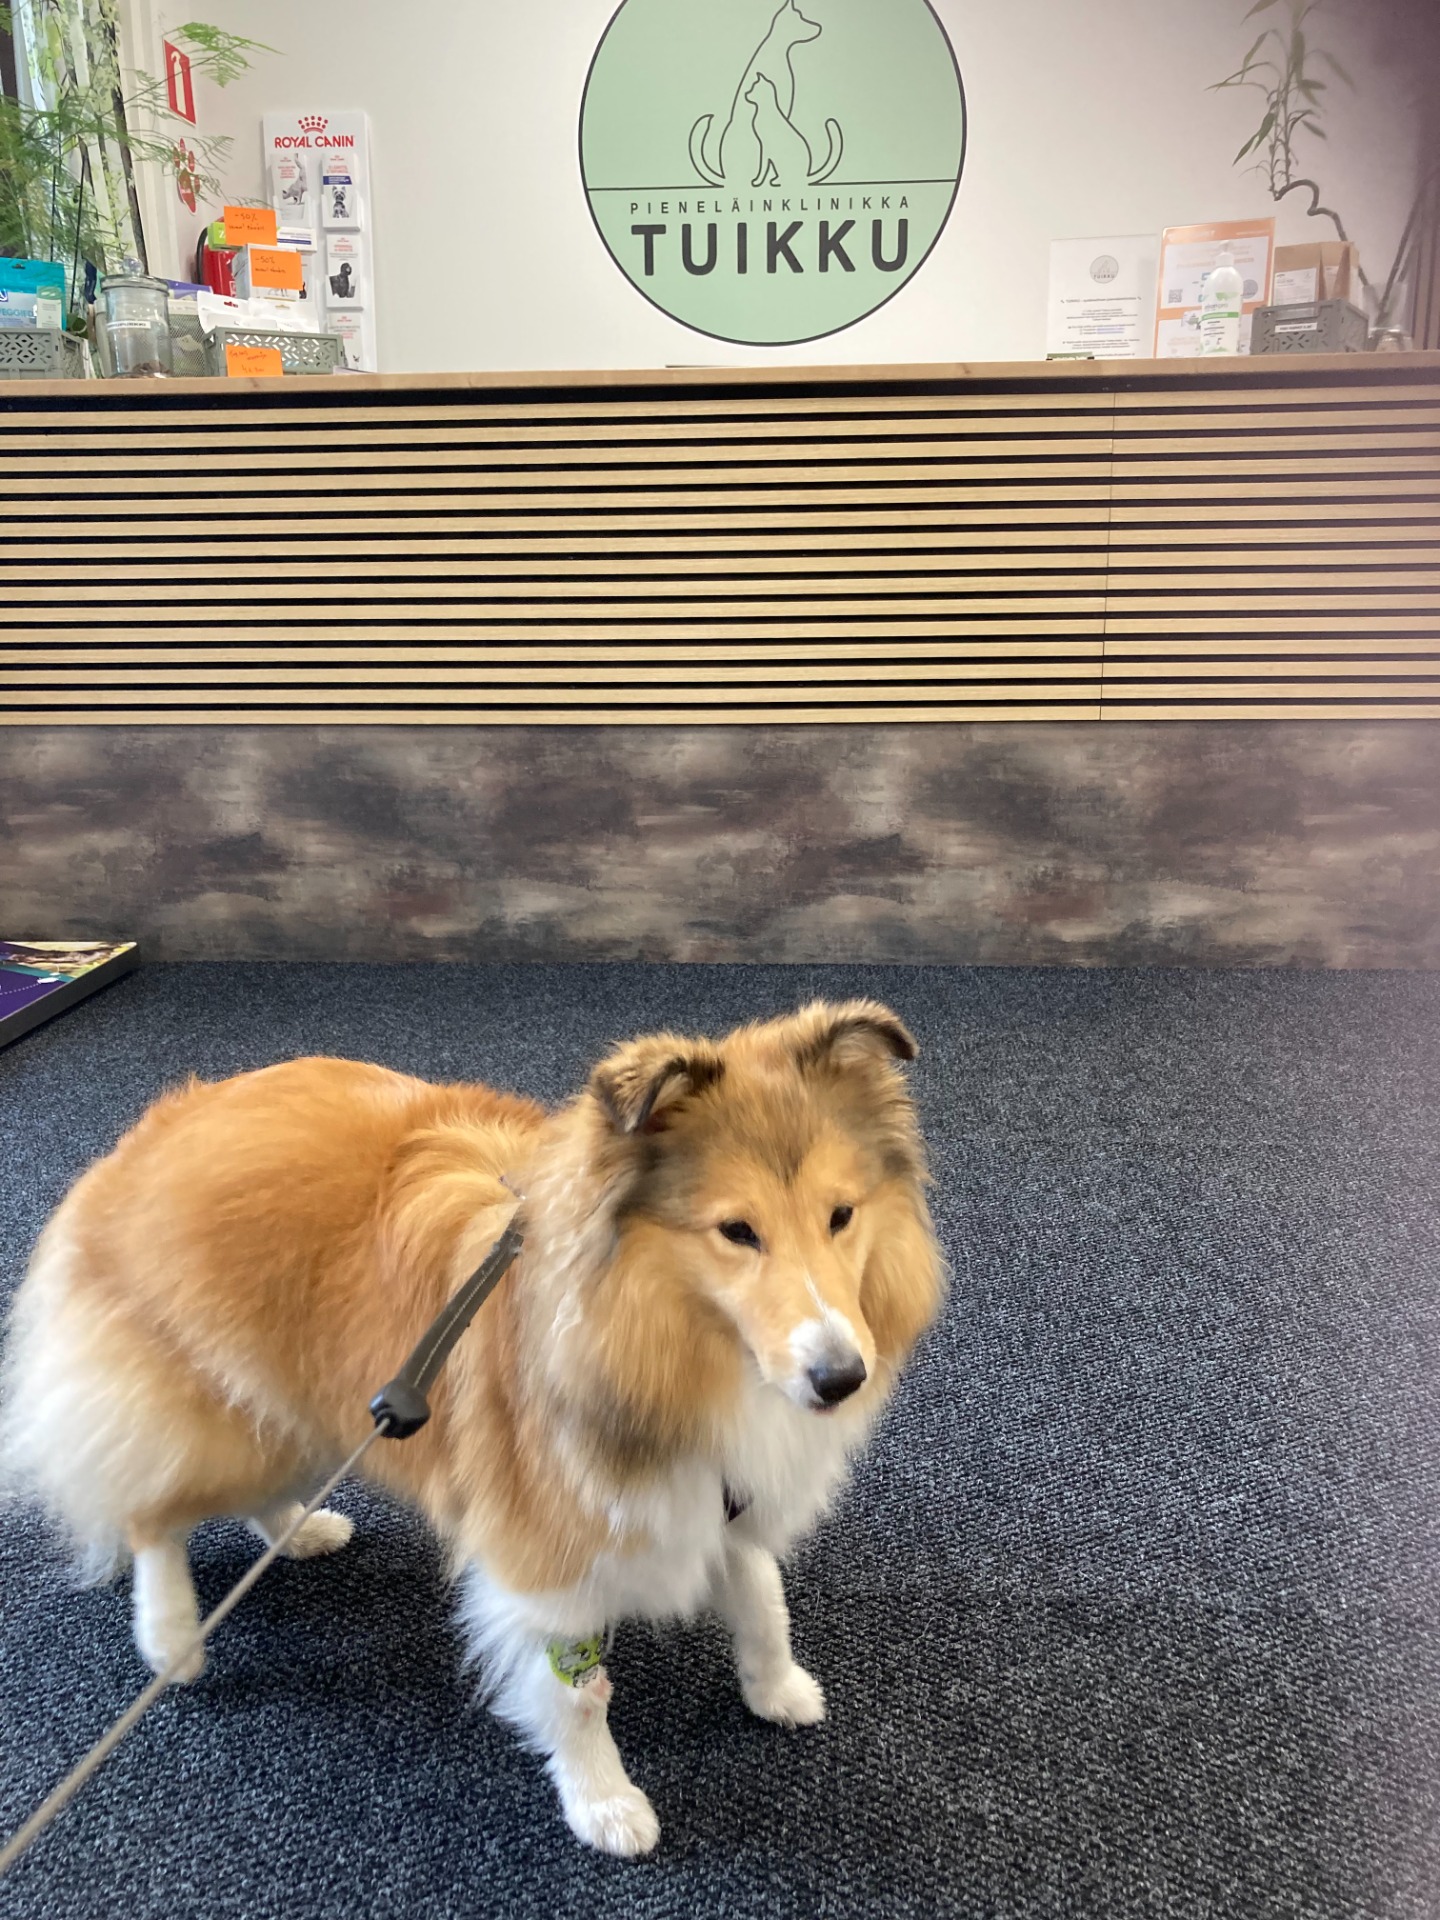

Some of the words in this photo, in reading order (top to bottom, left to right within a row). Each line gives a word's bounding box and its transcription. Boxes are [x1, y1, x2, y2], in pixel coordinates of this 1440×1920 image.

[274, 136, 312, 148] ROYAL
[315, 135, 354, 148] CANIN
[630, 196, 909, 214] PIENELÄINKLINIKKA
[631, 218, 908, 276] TUIKKU
[255, 256, 275, 264] -50%
